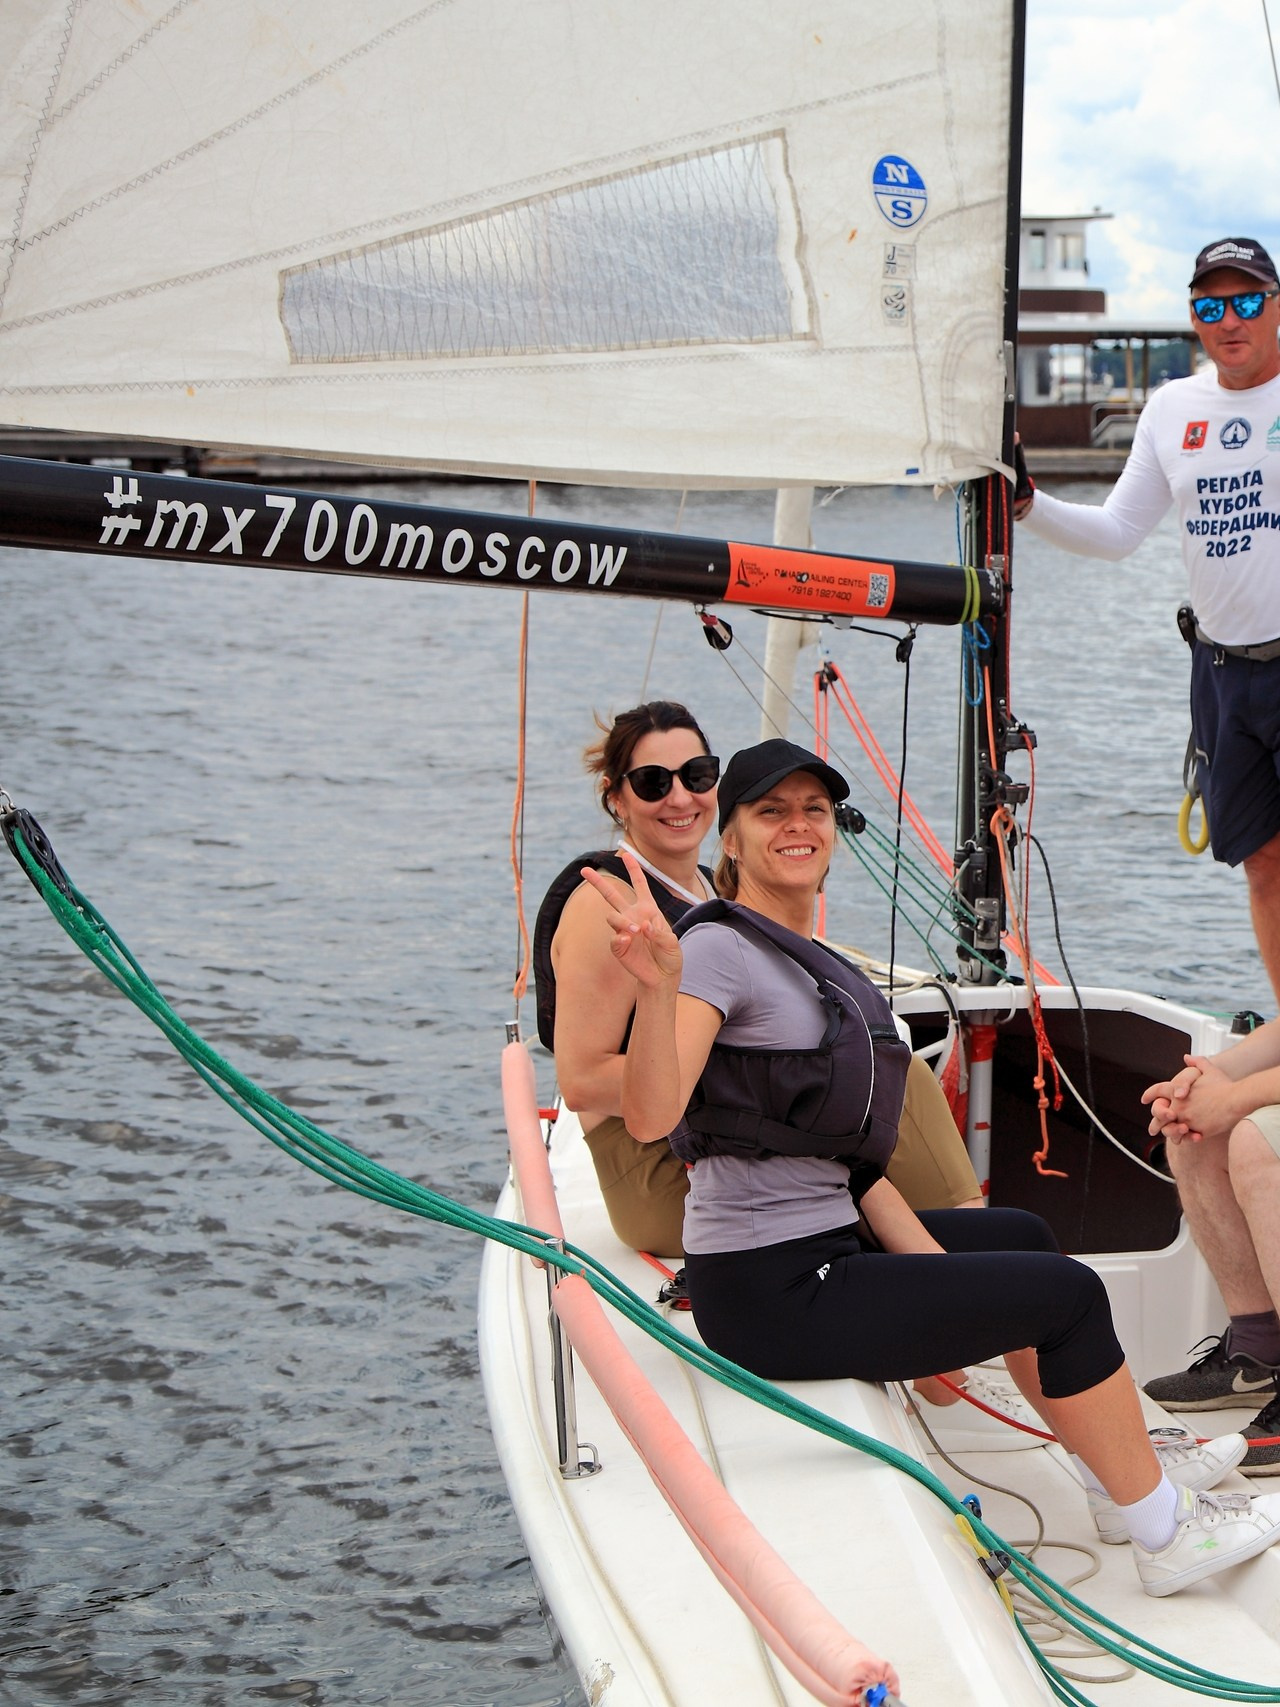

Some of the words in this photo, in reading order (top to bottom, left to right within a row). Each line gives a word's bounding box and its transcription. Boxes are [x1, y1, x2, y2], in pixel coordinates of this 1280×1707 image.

[883, 162, 910, 185] N
[891, 200, 913, 219] S
[1196, 469, 1264, 494] РЕГАТА
[1199, 491, 1263, 515] КУБОК
[98, 475, 629, 587] #mx700moscow
[1206, 534, 1253, 558] 2022
